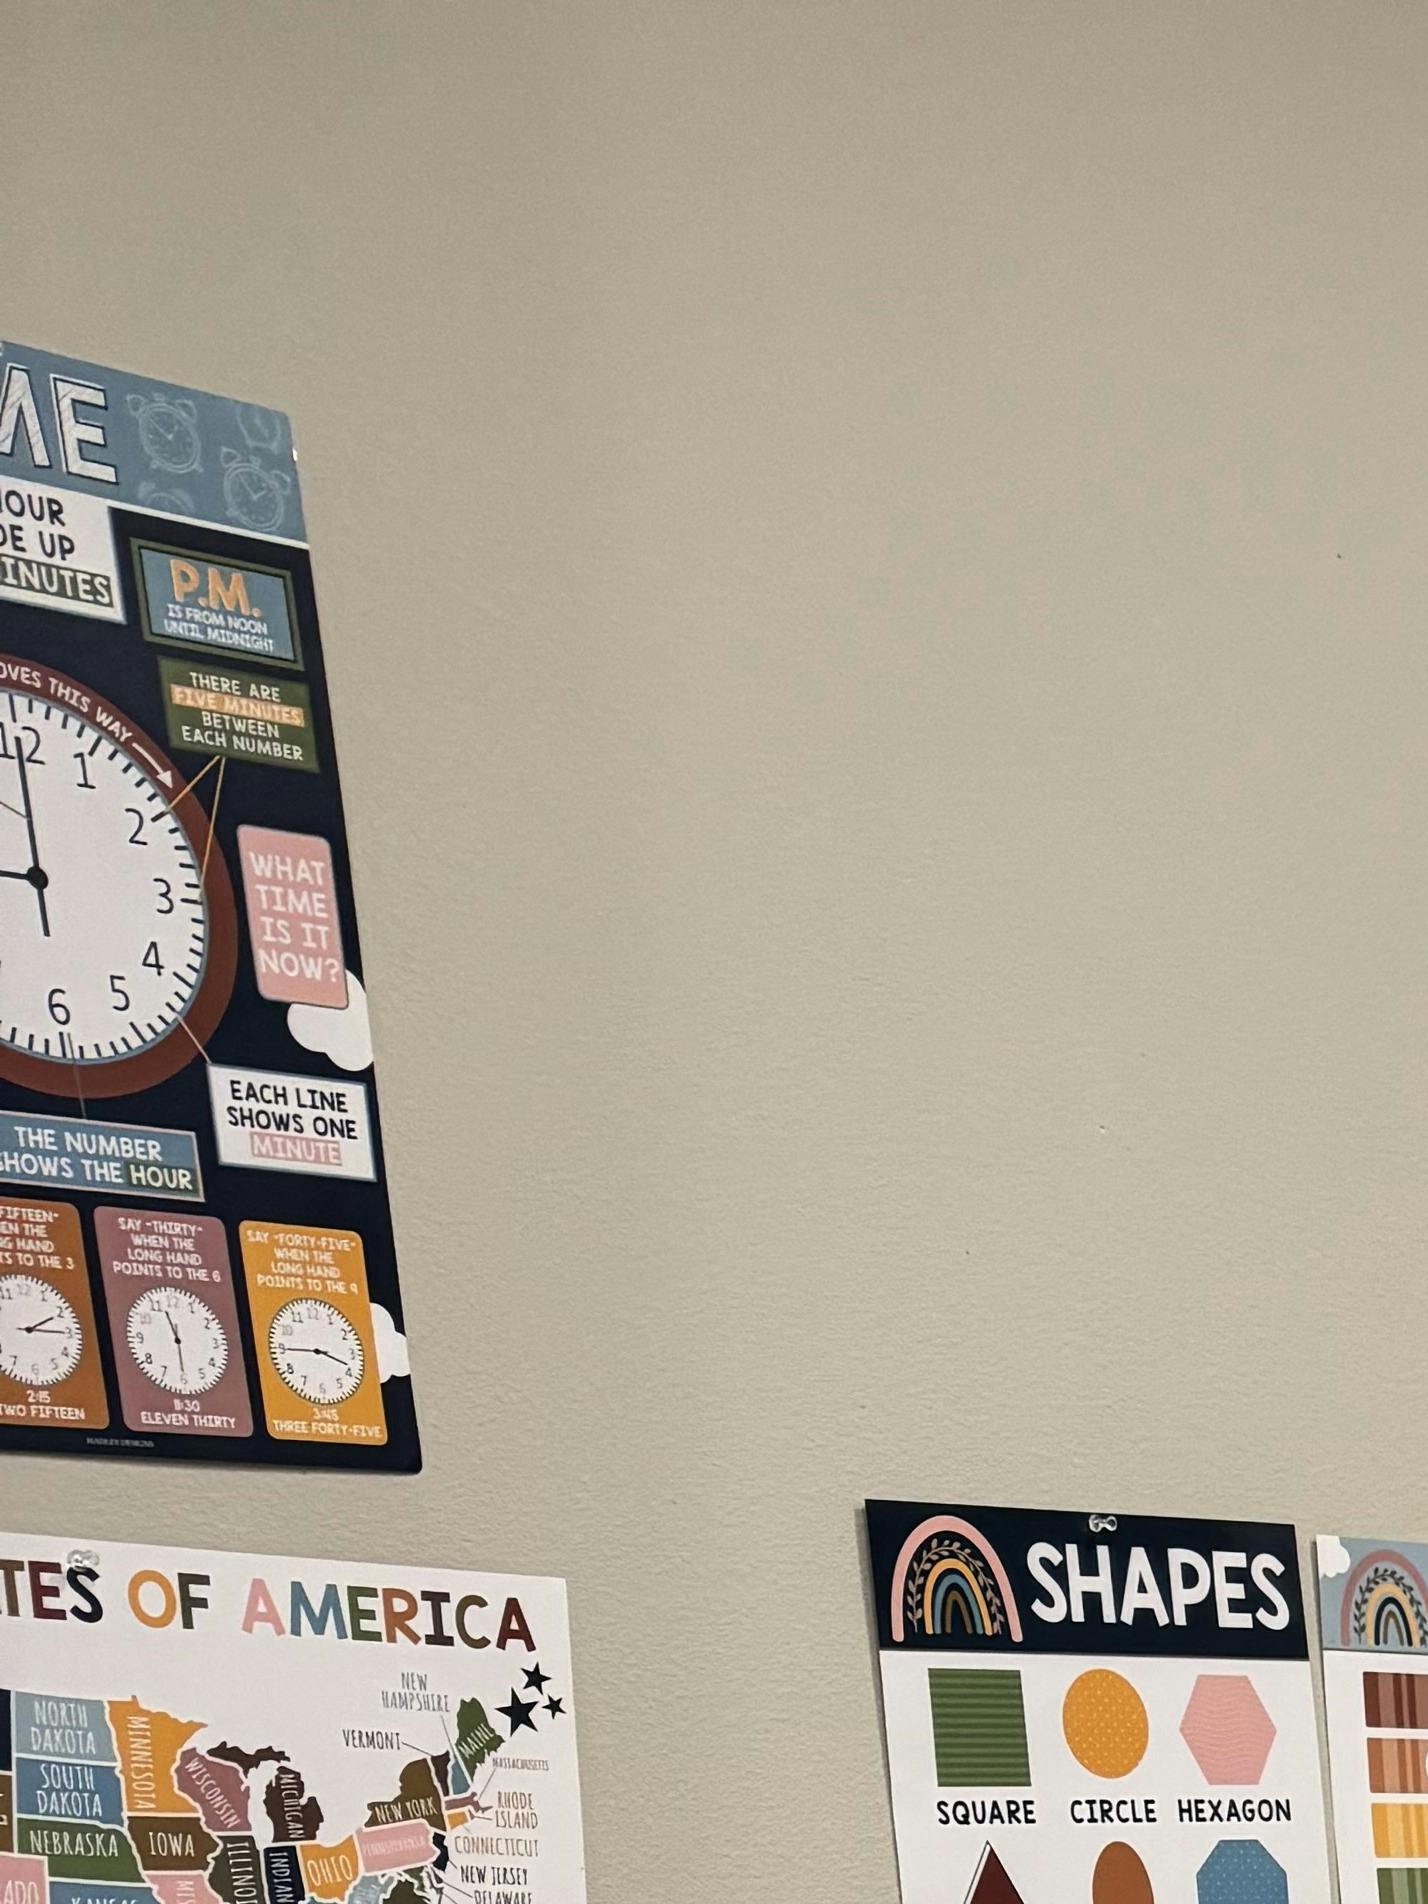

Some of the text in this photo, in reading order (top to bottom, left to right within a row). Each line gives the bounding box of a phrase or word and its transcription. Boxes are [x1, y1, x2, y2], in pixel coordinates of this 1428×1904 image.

[39, 531, 75, 561] UP
[170, 559, 262, 618] P.M.
[190, 672, 280, 702] THERE ARE
[173, 688, 302, 723] FIVE MINUTES
[202, 711, 279, 738] BETWEEN
[181, 726, 303, 760] EACH NUMBER
[249, 852, 325, 885] WHAT
[256, 885, 327, 918] TIME
[261, 916, 329, 949] IS IT
[256, 954, 341, 982] NOW?
[230, 1081, 347, 1112] EACH LINE
[228, 1107, 358, 1140] SHOWS ONE
[252, 1135, 340, 1163] MINUTE
[1026, 1540, 1292, 1631] SHAPES
[128, 1569, 537, 1653] OF AMERICA
[33, 1700, 88, 1729] NORTH
[31, 1727, 97, 1755] DAKOTA
[343, 1728, 402, 1751] VERMONT
[125, 1716, 156, 1810] MINNESOTA
[40, 1766, 94, 1791] SOUTH
[35, 1791, 102, 1817] DAKOTA
[936, 1799, 1292, 1825] SQUARE CIRCLE HEXAGON
[29, 1832, 118, 1858] NEBRASKA
[148, 1832, 195, 1858] IOWA
[454, 1835, 539, 1858] CONNECTICUT
[308, 1853, 353, 1887] OHIO
